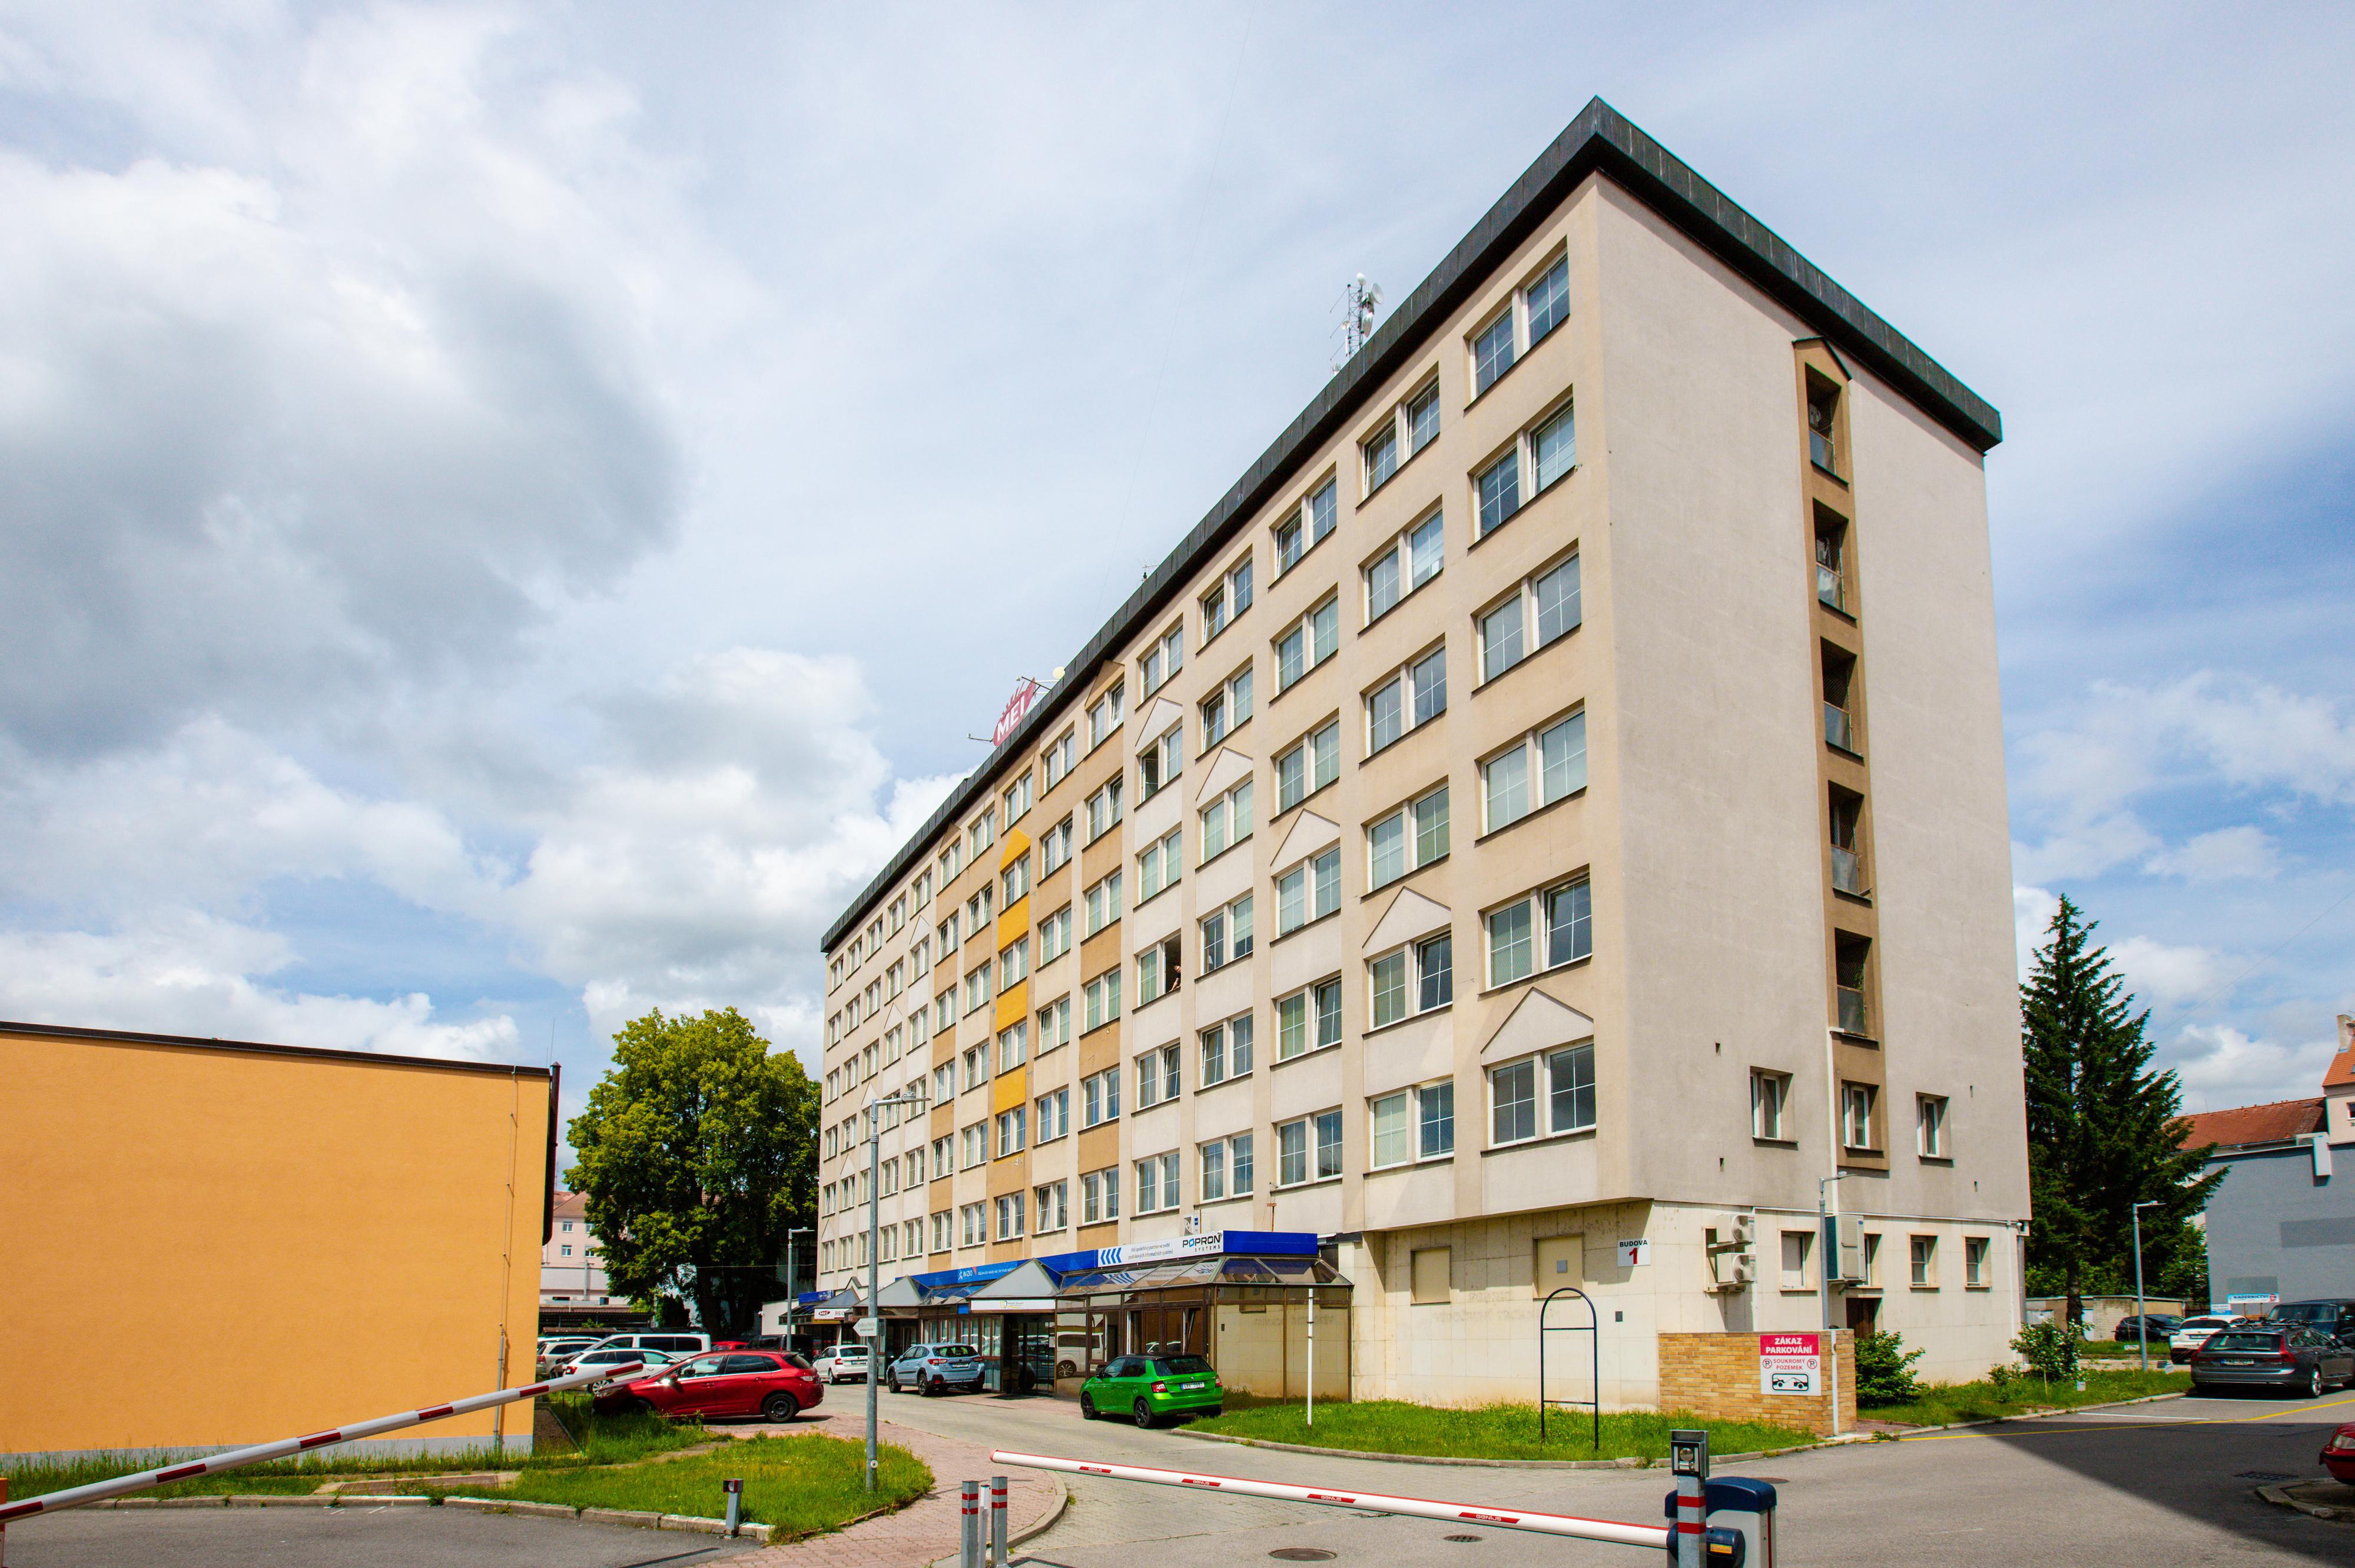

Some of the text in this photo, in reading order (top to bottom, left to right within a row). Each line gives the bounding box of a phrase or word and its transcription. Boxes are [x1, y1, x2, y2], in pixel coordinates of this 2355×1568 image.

[997, 695, 1025, 742] MEI
[1183, 1234, 1220, 1248] POPRON
[1629, 1247, 1637, 1264] 1
[1774, 1336, 1802, 1344] ZÁKAZ
[1766, 1345, 1813, 1354] PARKOVÁNÍ
